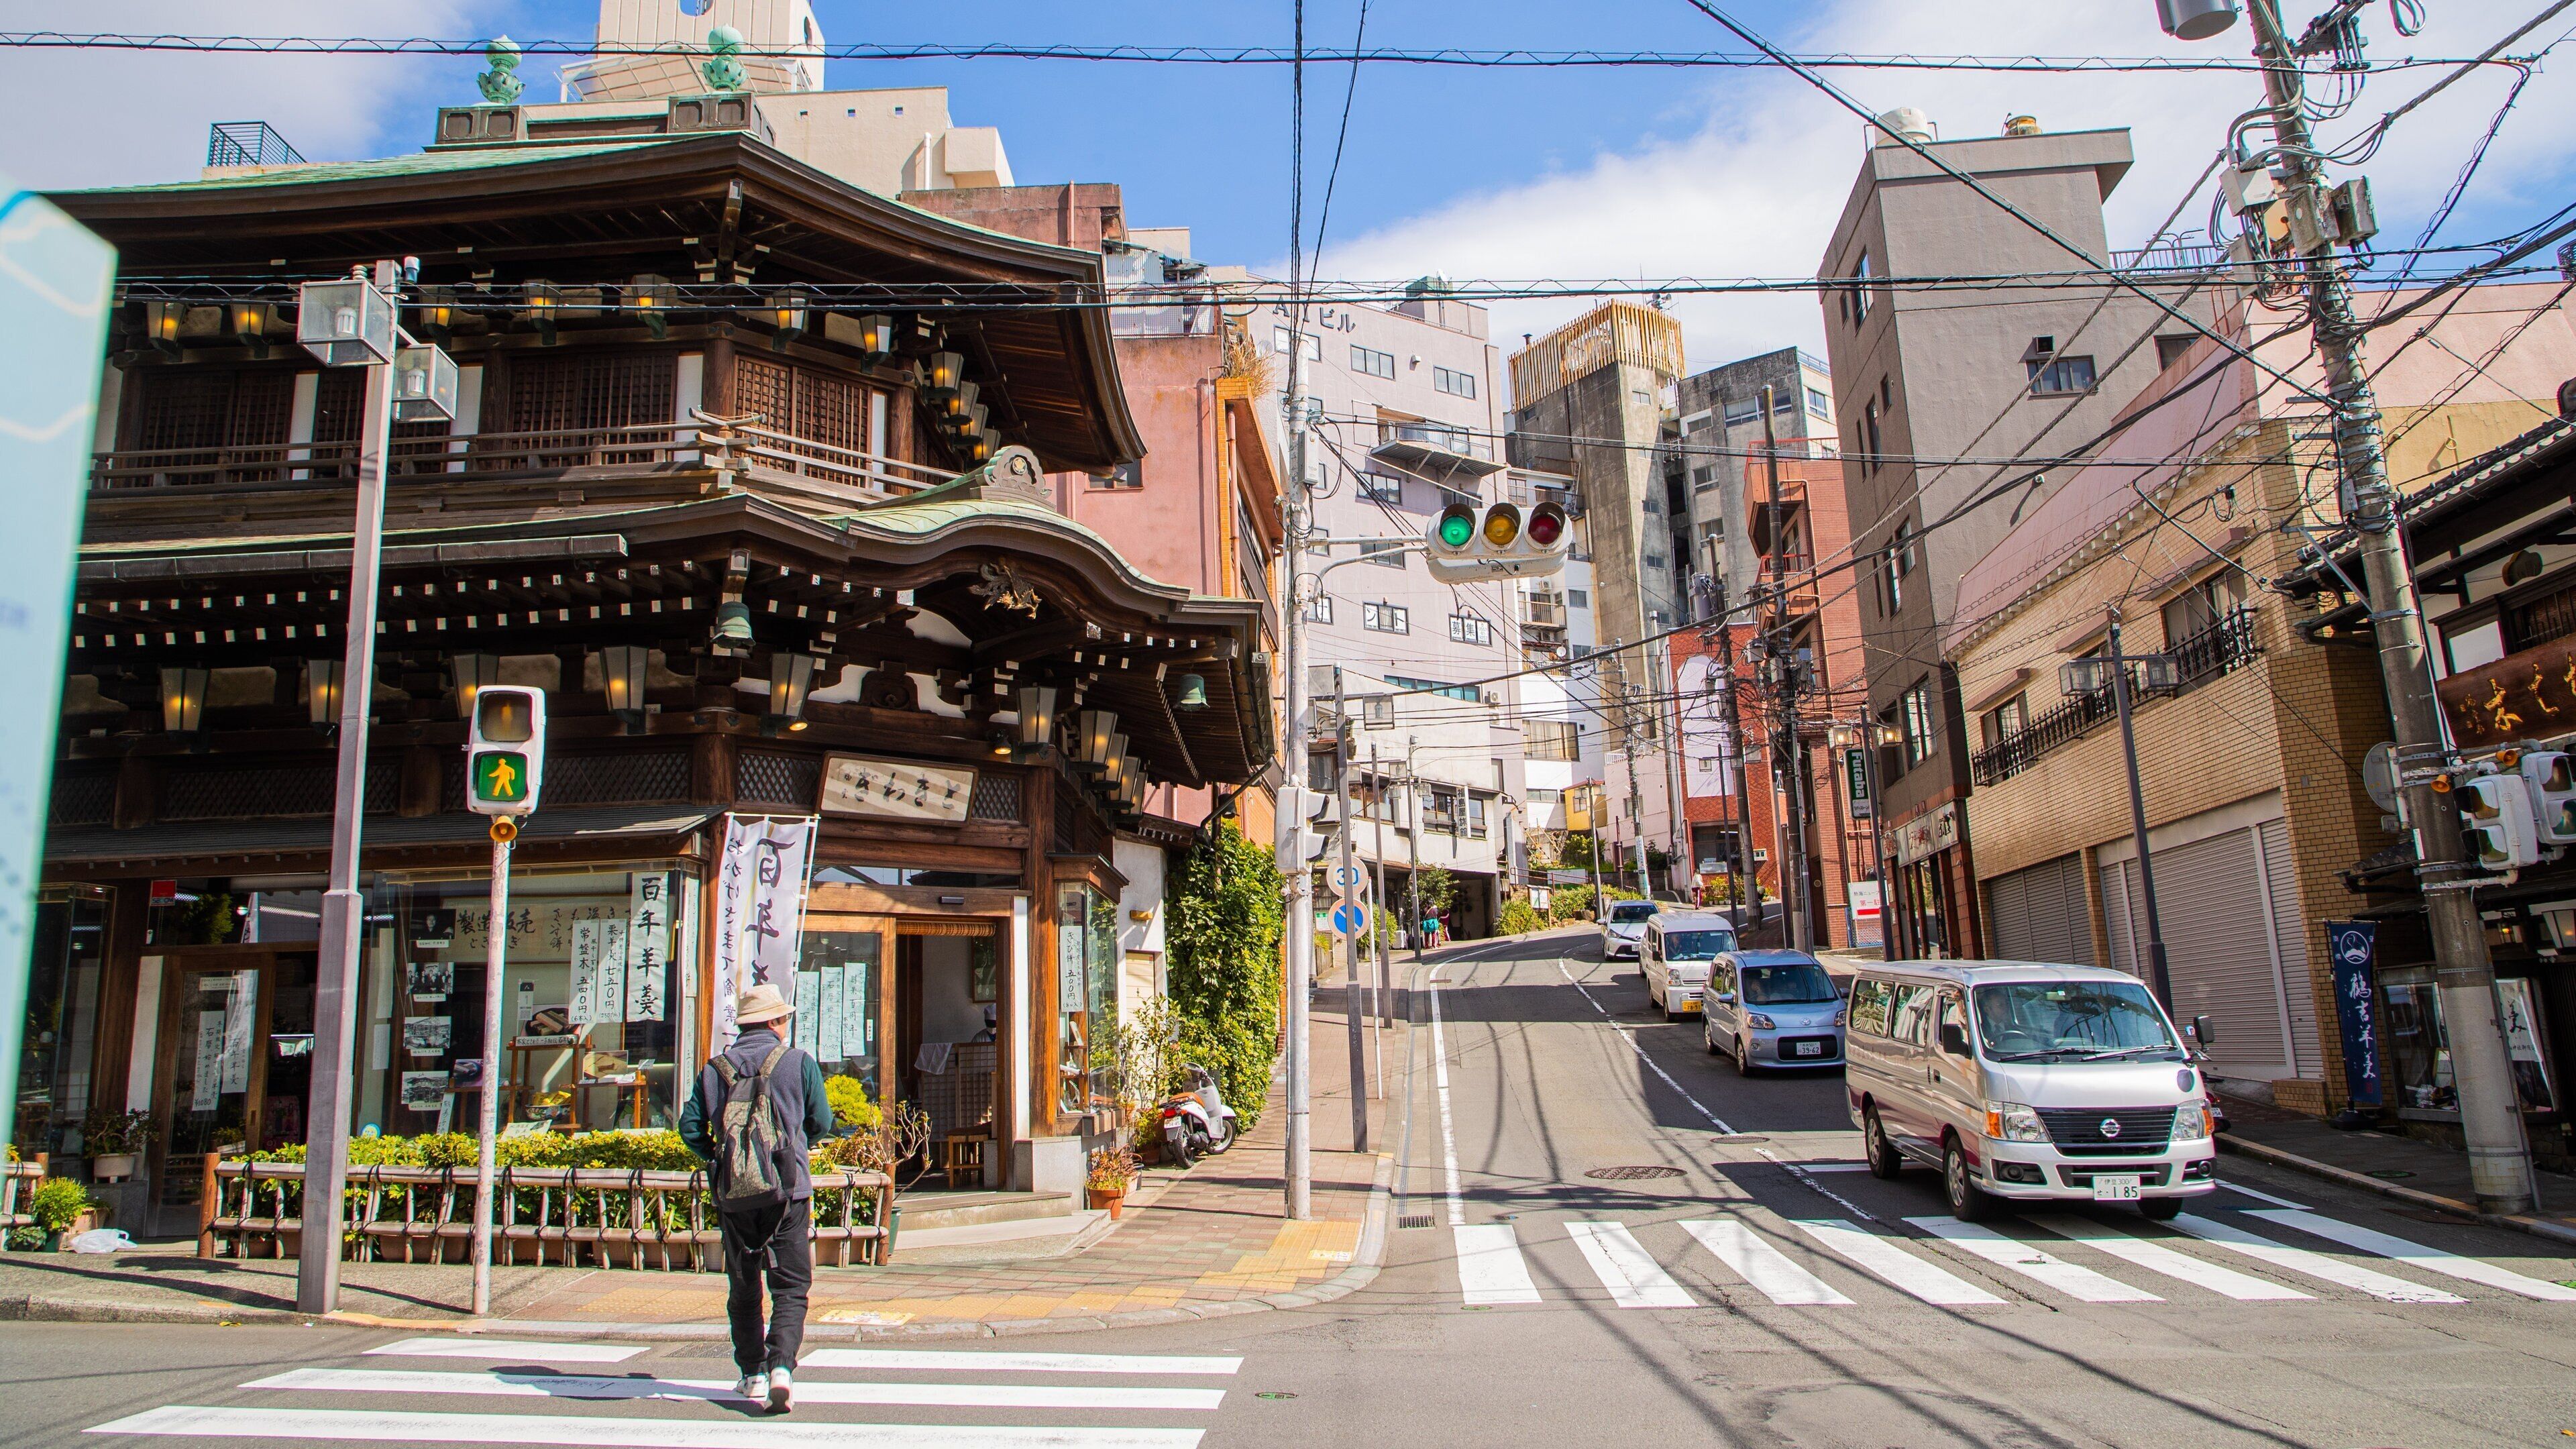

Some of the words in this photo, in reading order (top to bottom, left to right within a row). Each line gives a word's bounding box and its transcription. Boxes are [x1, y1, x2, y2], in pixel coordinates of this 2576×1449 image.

[1452, 621, 1475, 637] 募集
[1851, 752, 1866, 798] Futaba
[1457, 788, 1467, 837] 福島屋旅館
[1337, 867, 1358, 885] 30
[470, 934, 521, 949] ときぎ
[635, 877, 659, 1015] 百年羊羹
[195, 1098, 211, 1106] ¥1080
